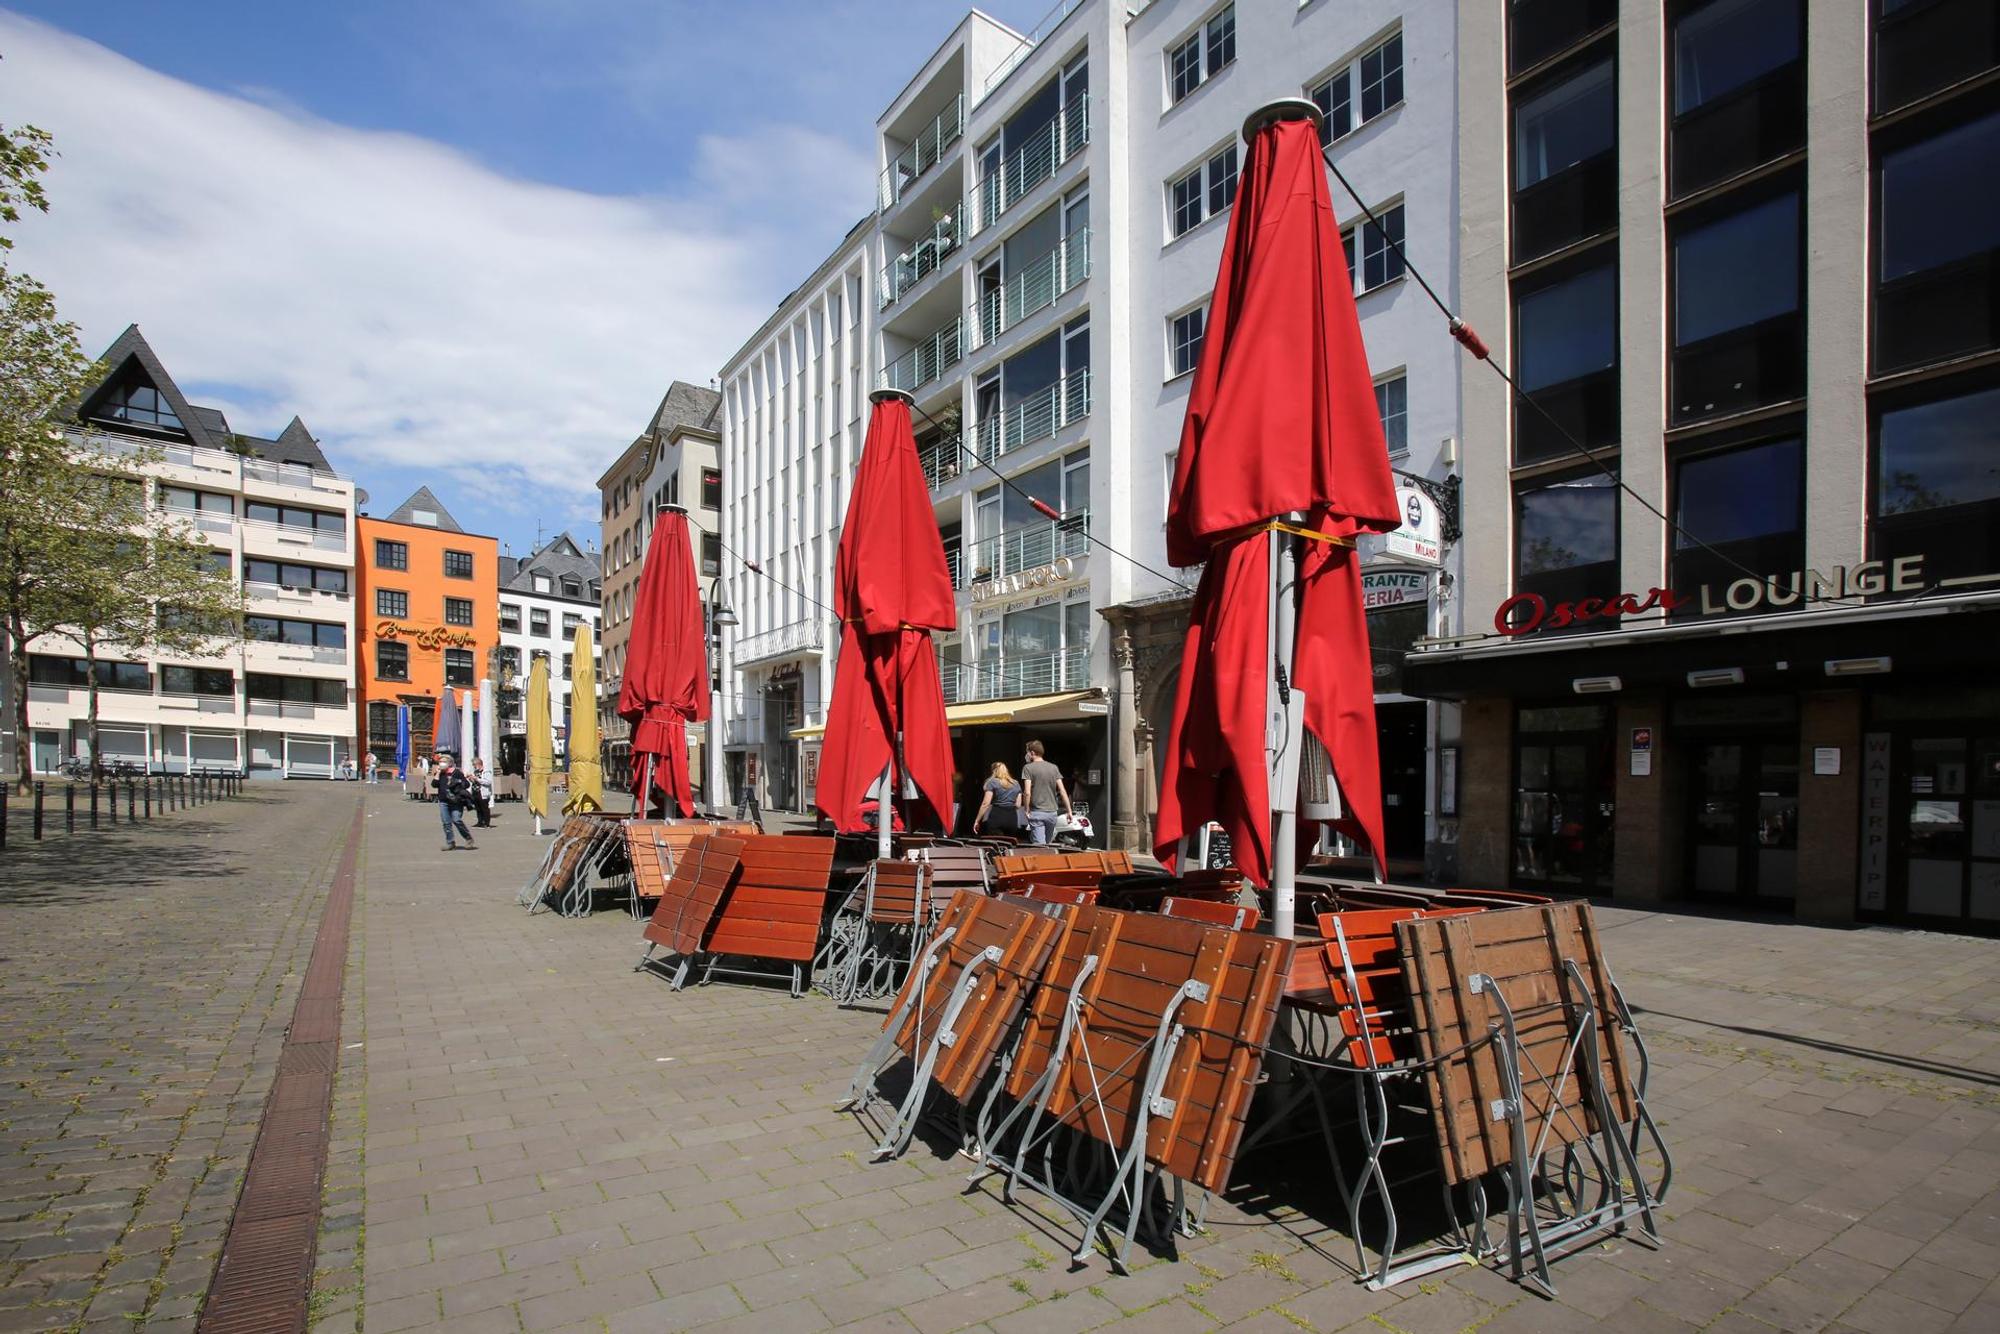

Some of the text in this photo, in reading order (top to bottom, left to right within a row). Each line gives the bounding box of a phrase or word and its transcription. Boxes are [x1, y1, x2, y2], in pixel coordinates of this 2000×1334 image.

[1415, 543, 1437, 559] MILANO
[1361, 575, 1421, 588] RANTE
[1494, 554, 1926, 636] Oscar LOUNGE
